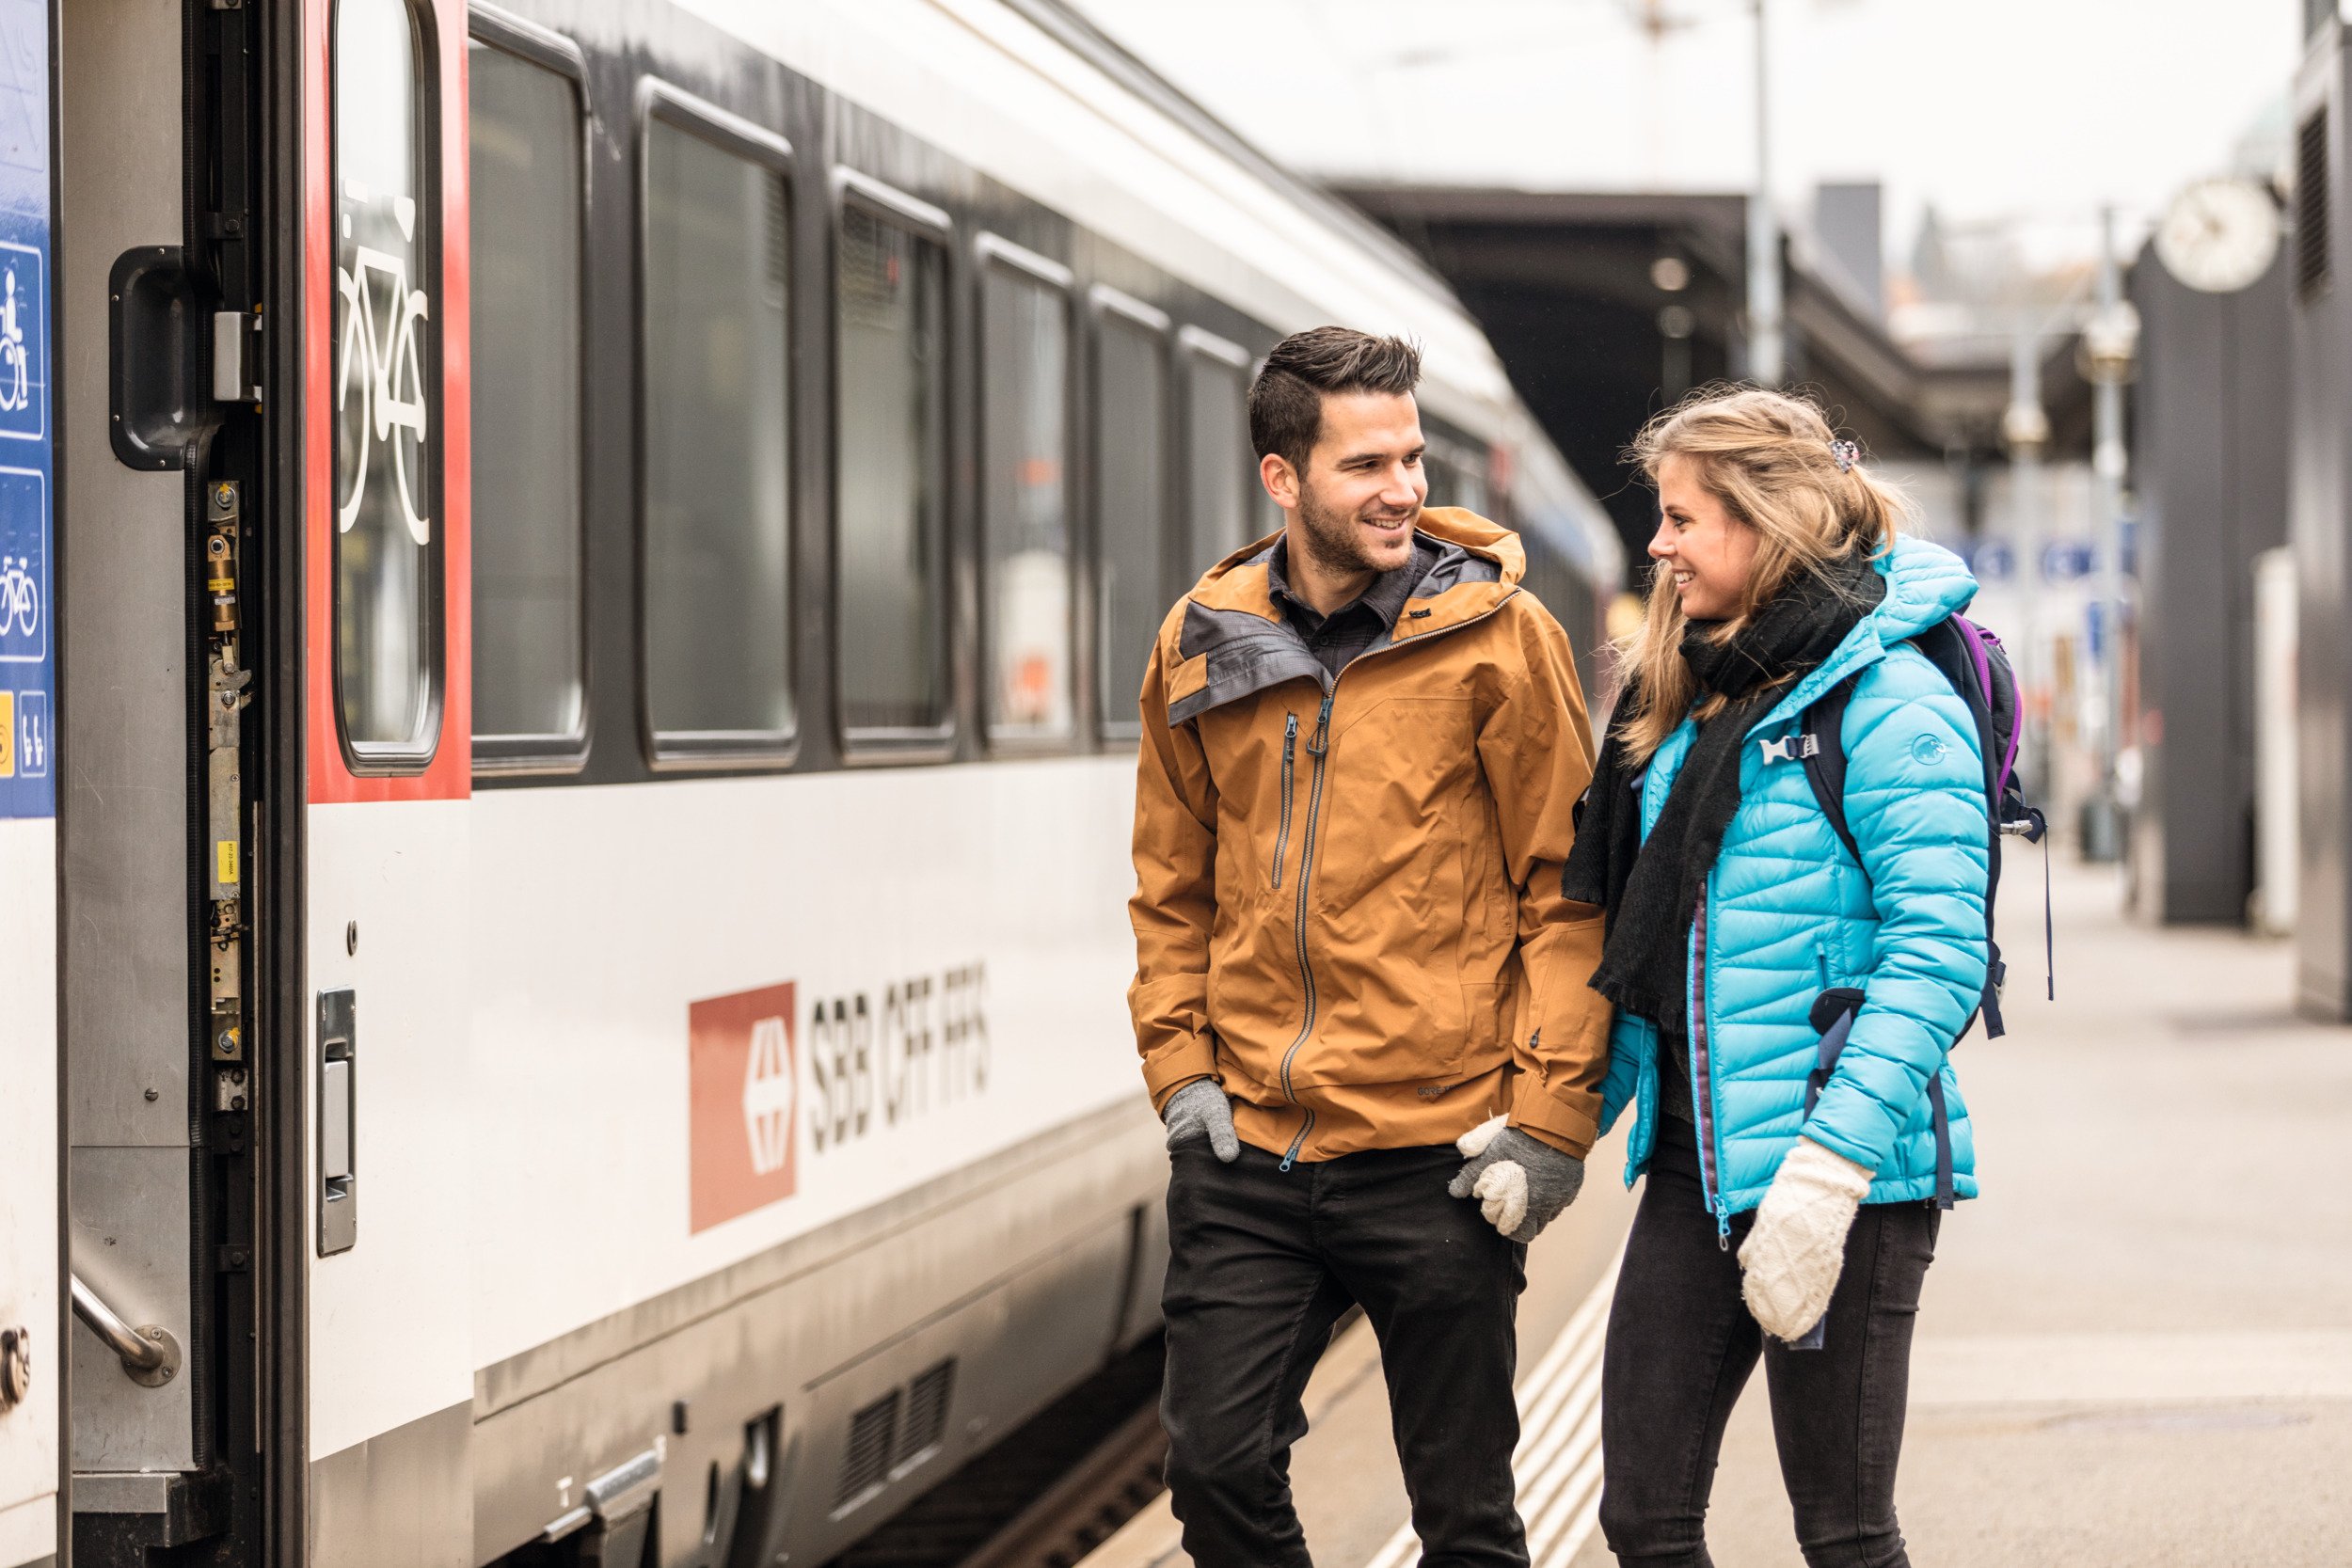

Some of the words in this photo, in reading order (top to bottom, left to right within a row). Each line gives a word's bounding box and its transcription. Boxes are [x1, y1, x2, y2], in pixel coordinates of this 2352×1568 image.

[809, 992, 871, 1155] SBB
[879, 975, 932, 1129] CFF
[1417, 1085, 1460, 1097] GORE-
